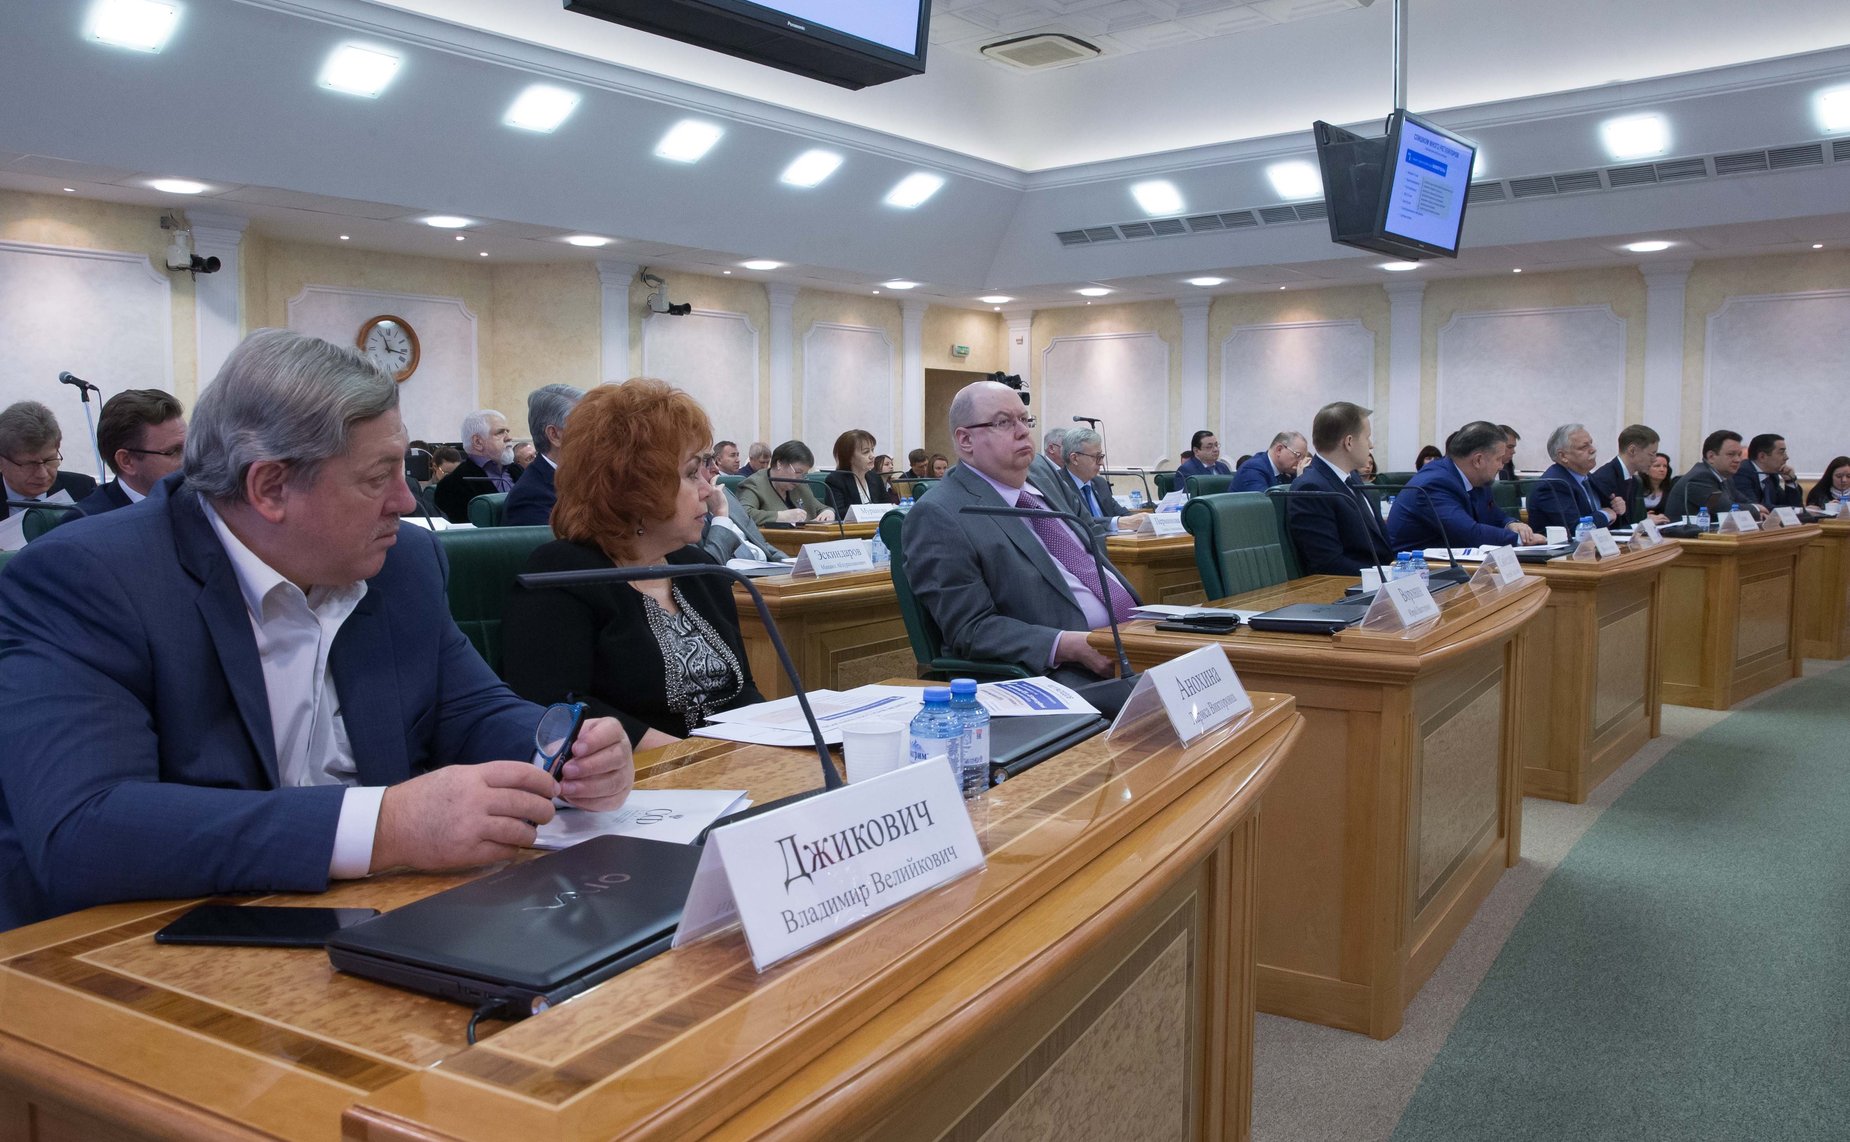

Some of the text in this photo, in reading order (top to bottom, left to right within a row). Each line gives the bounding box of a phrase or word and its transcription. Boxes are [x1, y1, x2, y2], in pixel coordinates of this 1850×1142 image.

[1175, 666, 1222, 701] Анохина
[775, 799, 935, 896] Джикович
[780, 844, 959, 935] Владимир Велийкович
